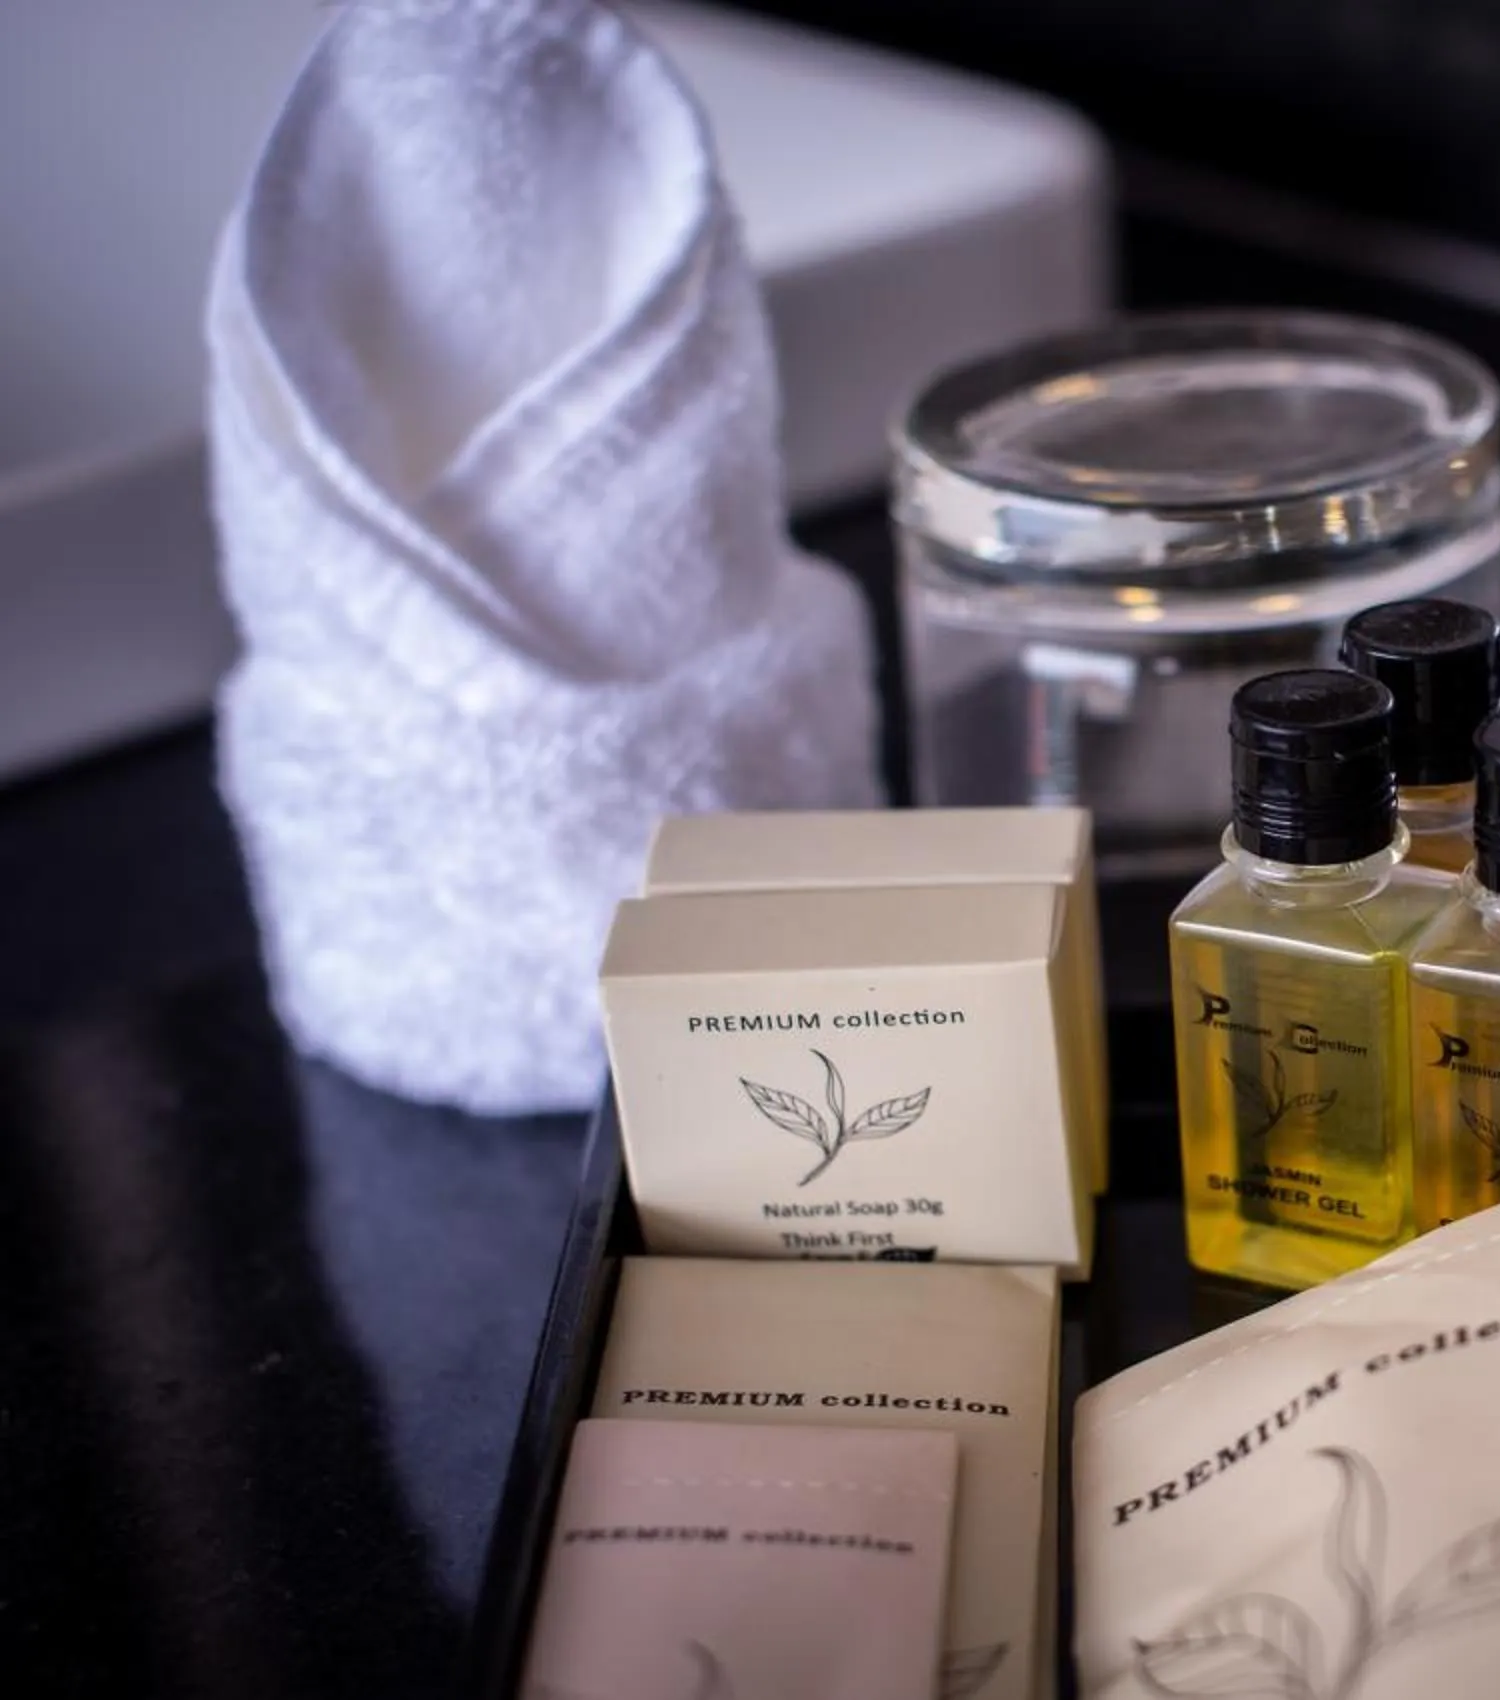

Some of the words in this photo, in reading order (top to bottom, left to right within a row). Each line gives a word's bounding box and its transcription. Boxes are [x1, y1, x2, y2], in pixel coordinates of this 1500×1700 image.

[688, 1013, 821, 1033] PREMIUM
[832, 1009, 966, 1029] collection
[762, 1201, 842, 1218] Natural
[847, 1200, 899, 1217] Soap
[905, 1198, 945, 1216] 30g
[1207, 1173, 1311, 1208] SHOWER
[1317, 1195, 1366, 1219] GEL
[780, 1231, 842, 1248] Think
[848, 1230, 896, 1247] First
[622, 1389, 806, 1409] PREMIUM
[821, 1392, 1011, 1417] collection
[1113, 1370, 1344, 1526] PREMIUM
